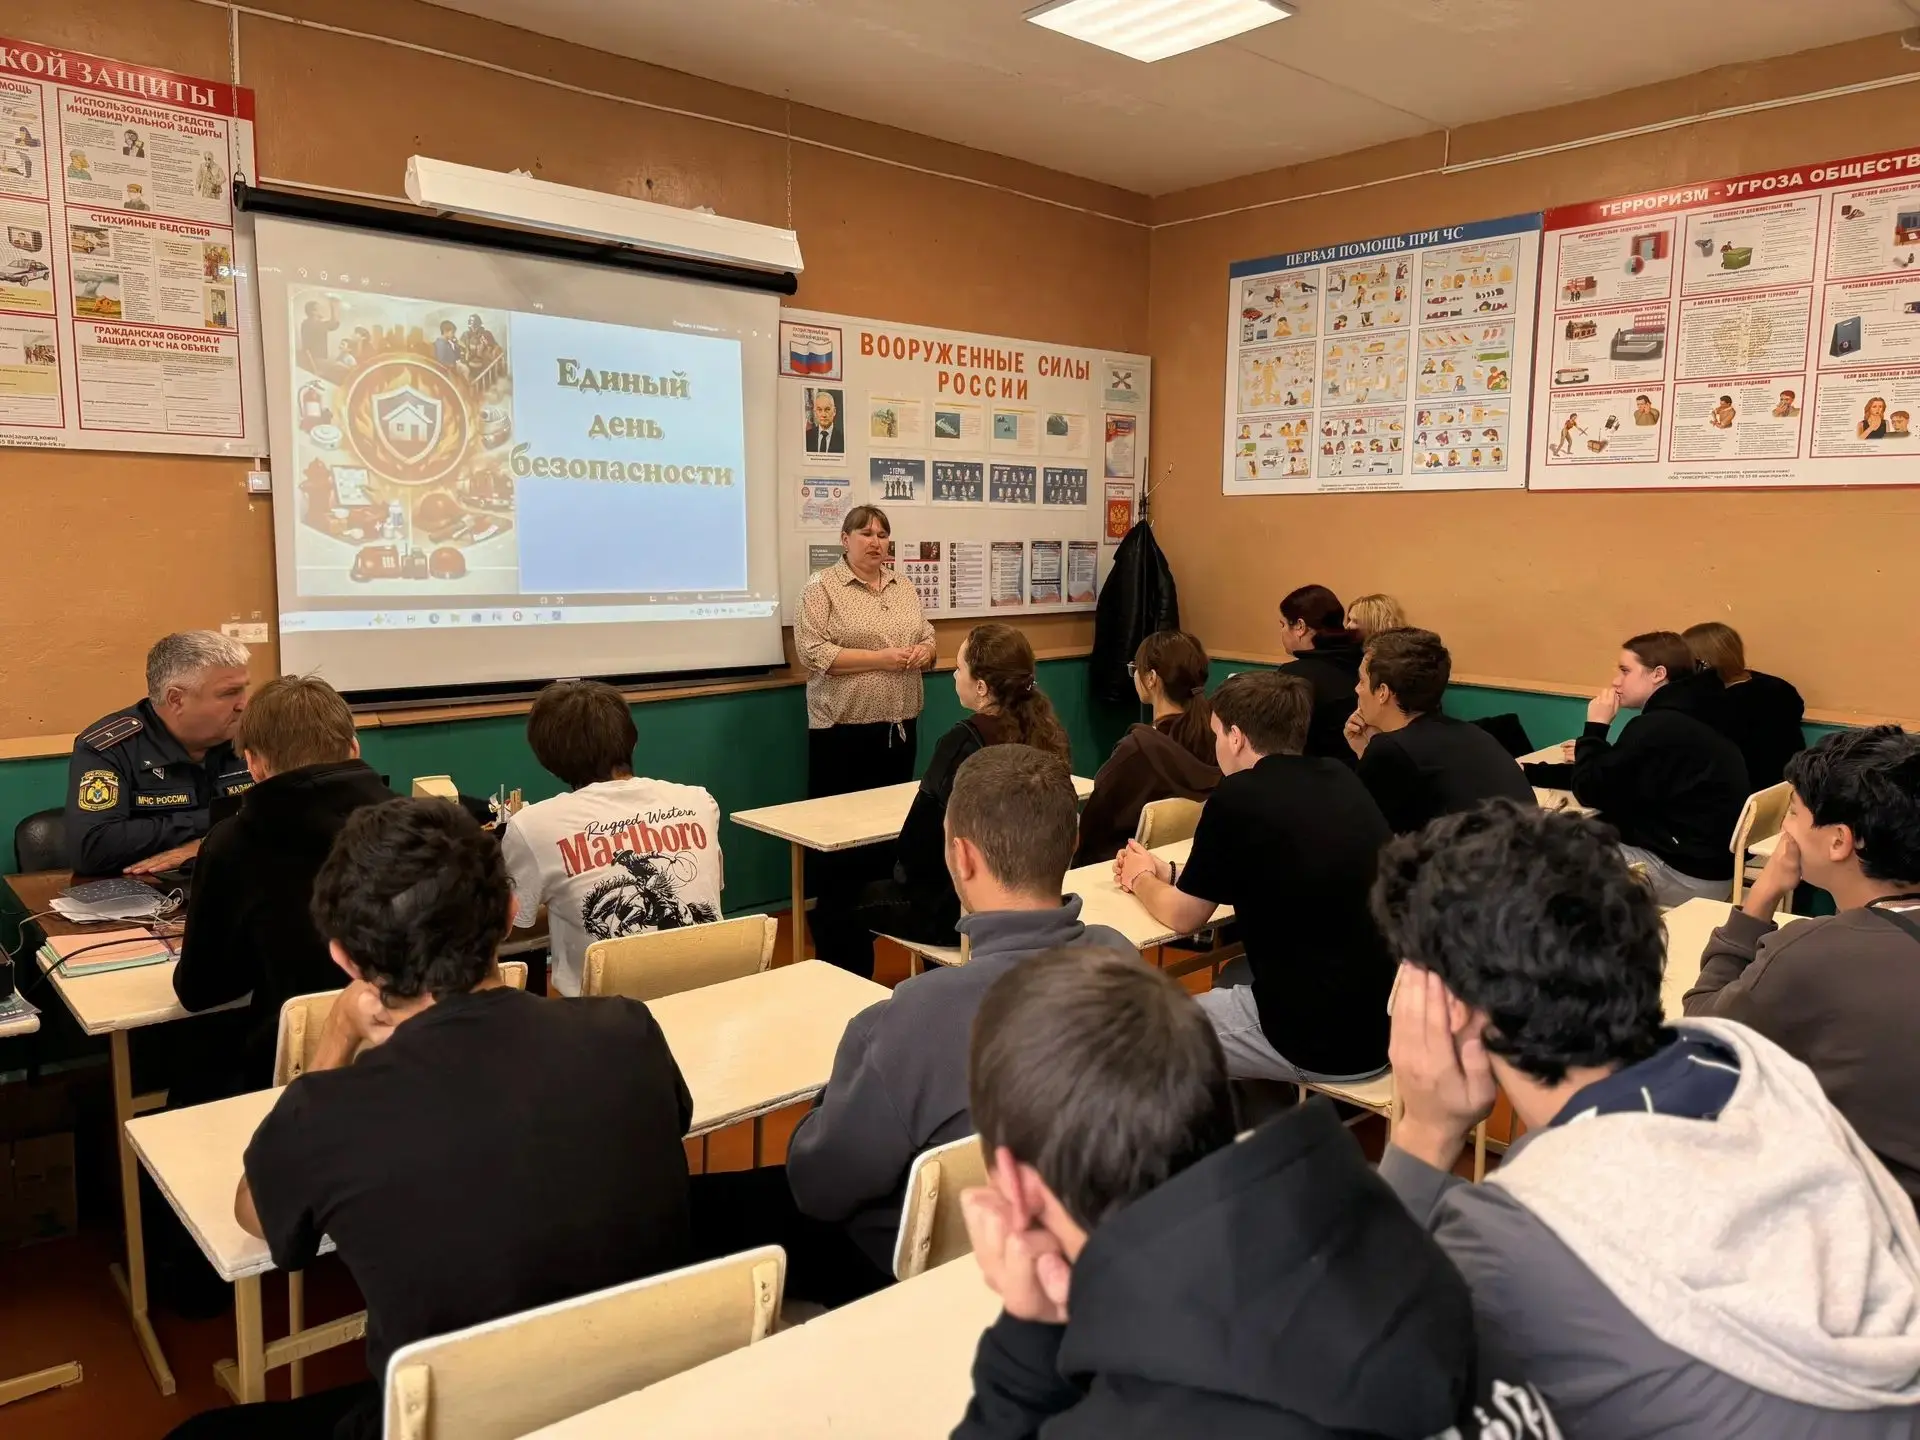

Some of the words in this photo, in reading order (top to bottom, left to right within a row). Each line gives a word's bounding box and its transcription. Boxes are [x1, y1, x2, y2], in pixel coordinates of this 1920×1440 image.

[77, 62, 216, 108] ЗАЩИТЫ
[66, 104, 175, 130] ИНДИВИДУАЛЬНОЙ
[177, 124, 222, 139] ЗАЩИТЫ
[74, 96, 169, 120] ИСПОЛЬЗОВАНИЕ
[172, 113, 215, 129] СРЕДСТВ
[1600, 188, 1709, 217] ТЕРРОРИЗМ
[1726, 172, 1804, 196] УГРОЗА
[1810, 153, 1920, 184] ОБЩЕСТВ
[91, 213, 157, 230] СТИХИЙНЫЕ
[159, 223, 210, 237] БЕДСТВИЯ
[1286, 246, 1336, 267] ПЕРВАЯ
[1339, 235, 1406, 259] ПОМОЩЬ
[1409, 229, 1440, 247] ПРИ
[1442, 226, 1465, 241] ЧС
[94, 326, 165, 340] ГРАЖДАНСКАЯ
[167, 333, 212, 344] ОБОРОНА
[96, 336, 137, 347] ЗАЩИТА
[139, 339, 151, 348] ОТ
[152, 341, 164, 349] ЧС
[166, 342, 179, 350] НА
[181, 343, 219, 353] ОБЪЕКТЕ
[860, 332, 1024, 374] ВООРУЖЕННЫЕ
[1038, 355, 1091, 381] СИЛЫ
[556, 357, 691, 399] Единый
[938, 370, 1029, 401] РОССИИ
[587, 413, 665, 441] день
[510, 442, 735, 487] безопасности
[138, 795, 154, 805] МЧС
[156, 794, 188, 804] РОССИИ
[585, 813, 642, 841] Rugged
[645, 806, 697, 824] Western
[556, 820, 707, 878] Marlboro
